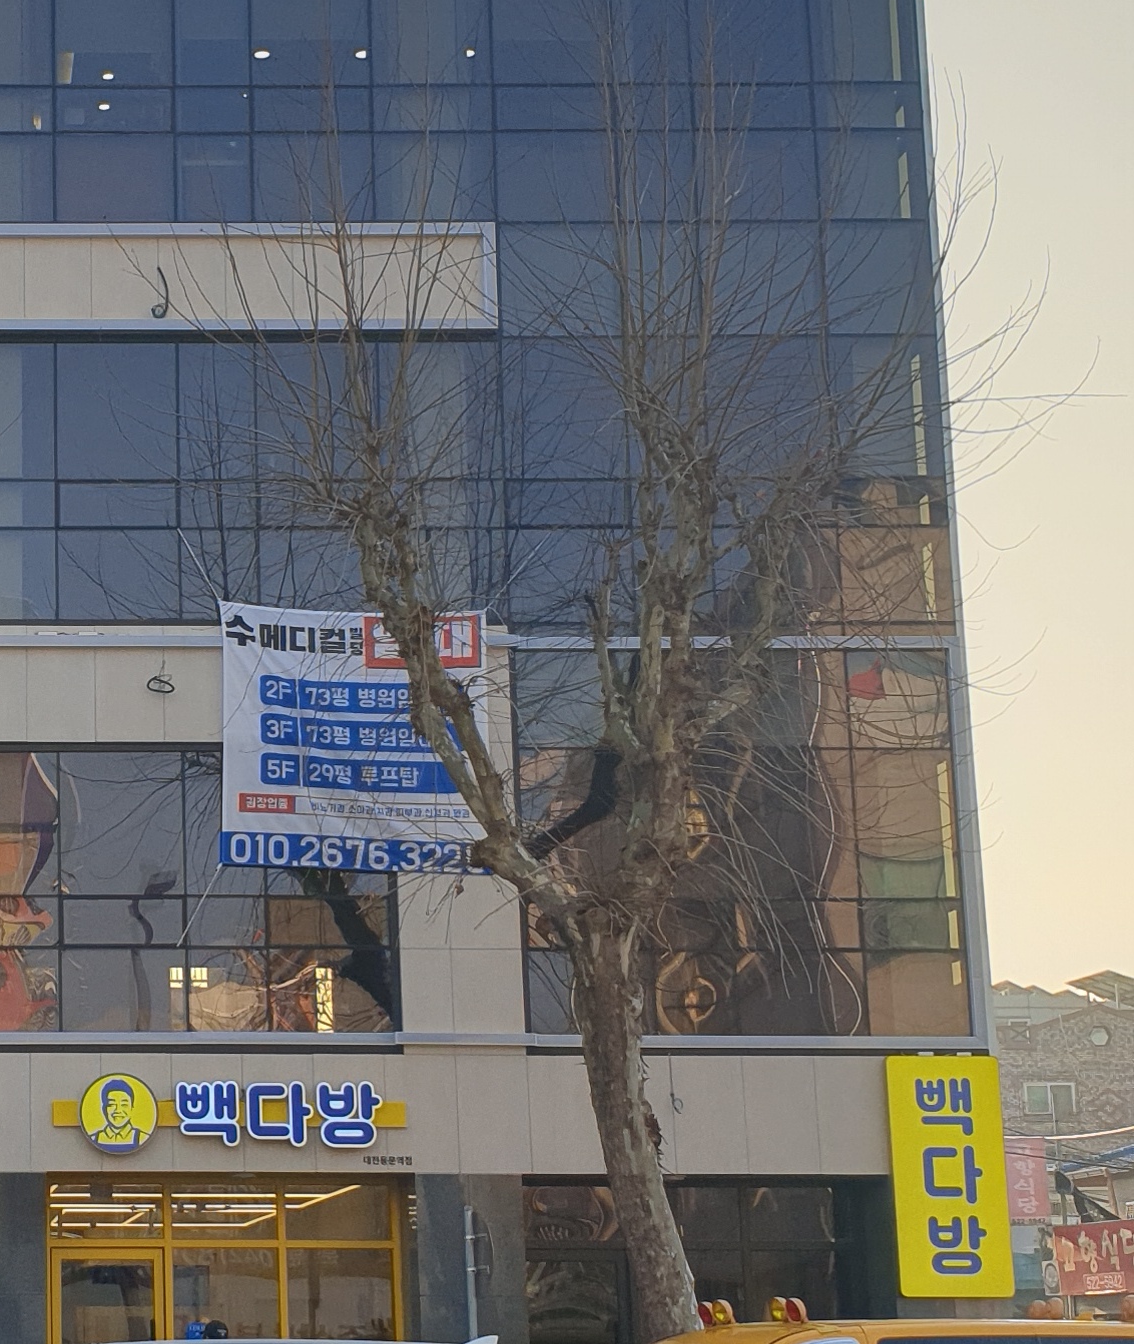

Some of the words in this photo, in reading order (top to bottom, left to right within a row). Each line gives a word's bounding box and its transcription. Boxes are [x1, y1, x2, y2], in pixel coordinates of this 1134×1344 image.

[265, 679, 293, 700] 2F
[304, 686, 350, 707] 73평
[357, 687, 413, 709] 병원임
[266, 719, 293, 739] 3F
[306, 725, 351, 746] 73평
[266, 759, 295, 779] 5F
[308, 763, 352, 785] 29평
